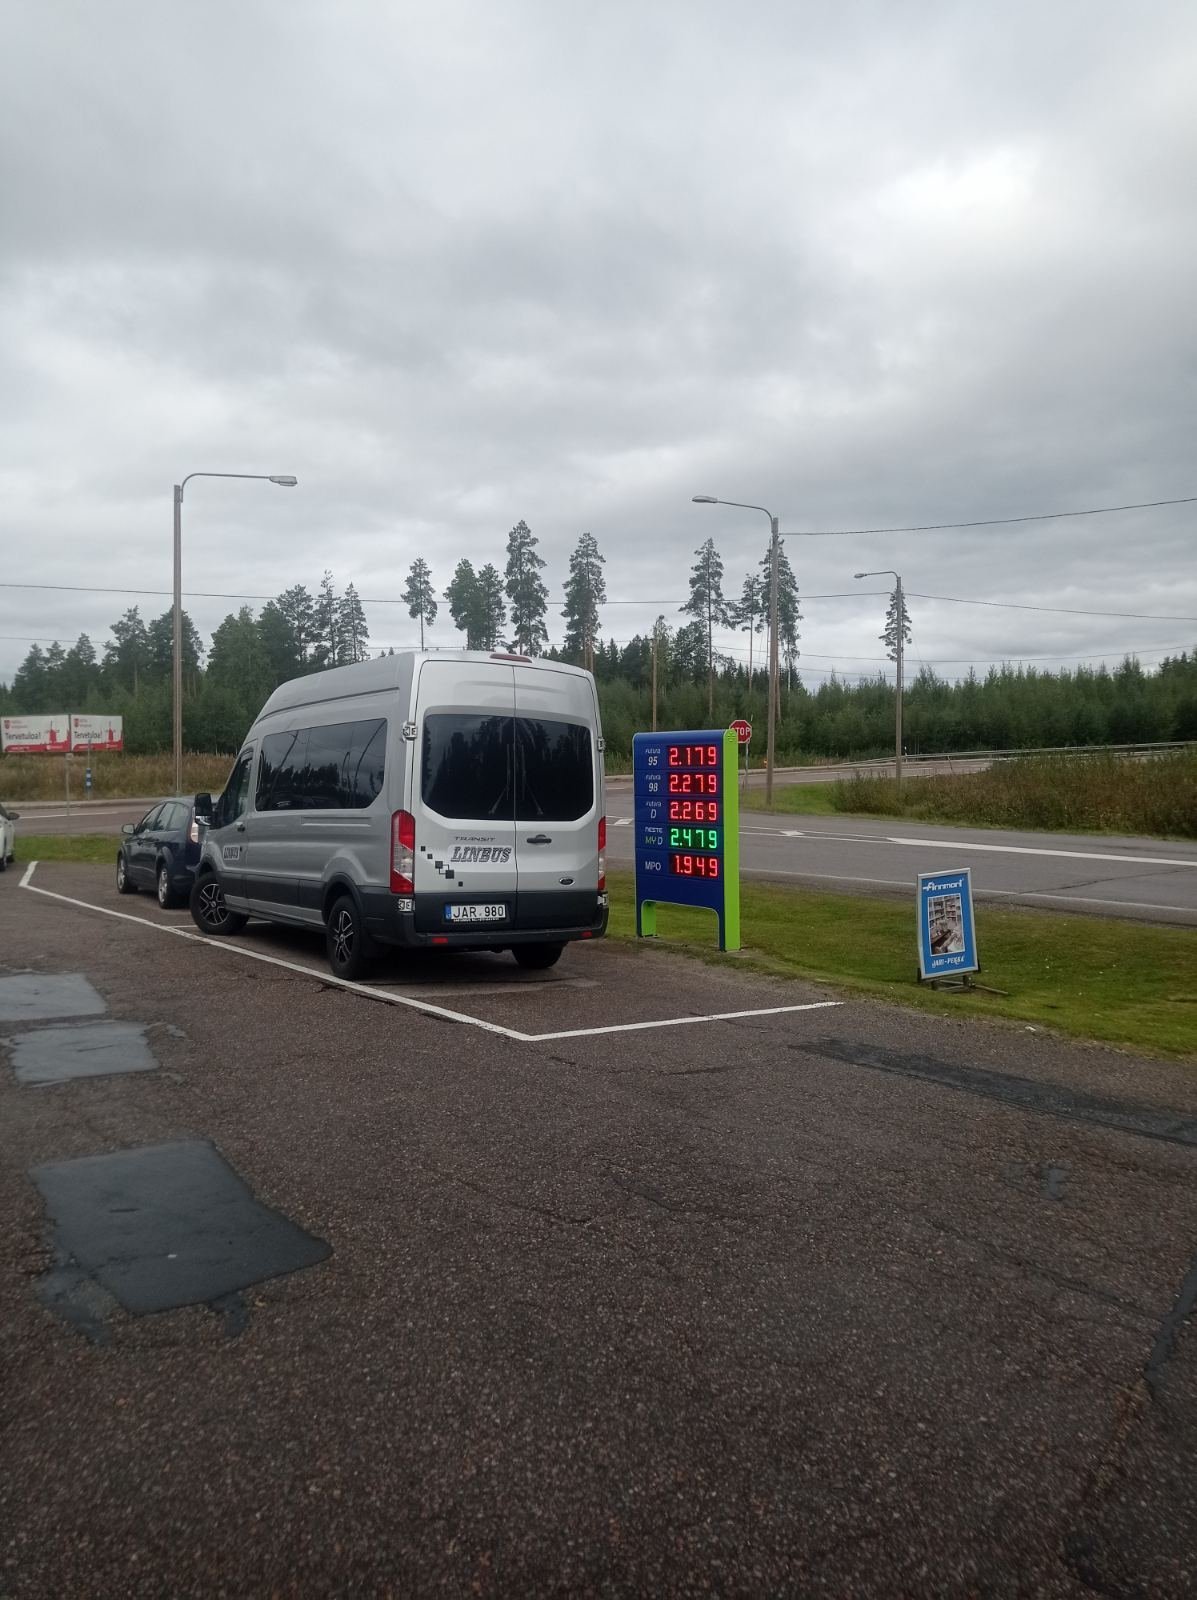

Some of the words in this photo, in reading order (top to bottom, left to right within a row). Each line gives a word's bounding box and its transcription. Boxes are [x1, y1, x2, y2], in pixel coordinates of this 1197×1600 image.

[732, 727, 750, 736] TOP
[648, 756, 658, 766] 95
[669, 746, 717, 766] 2.179
[648, 783, 658, 792] 98
[670, 774, 717, 793] 2.279
[650, 808, 657, 819] D
[670, 801, 717, 820] 2.269
[645, 836, 656, 845] MY
[657, 837, 663, 845] D
[671, 828, 718, 849] 2.479
[450, 846, 511, 863] LINBUS
[645, 861, 661, 871] MPO
[675, 855, 718, 877] 1.949
[453, 906, 477, 918] JAR
[484, 906, 504, 917] 980
